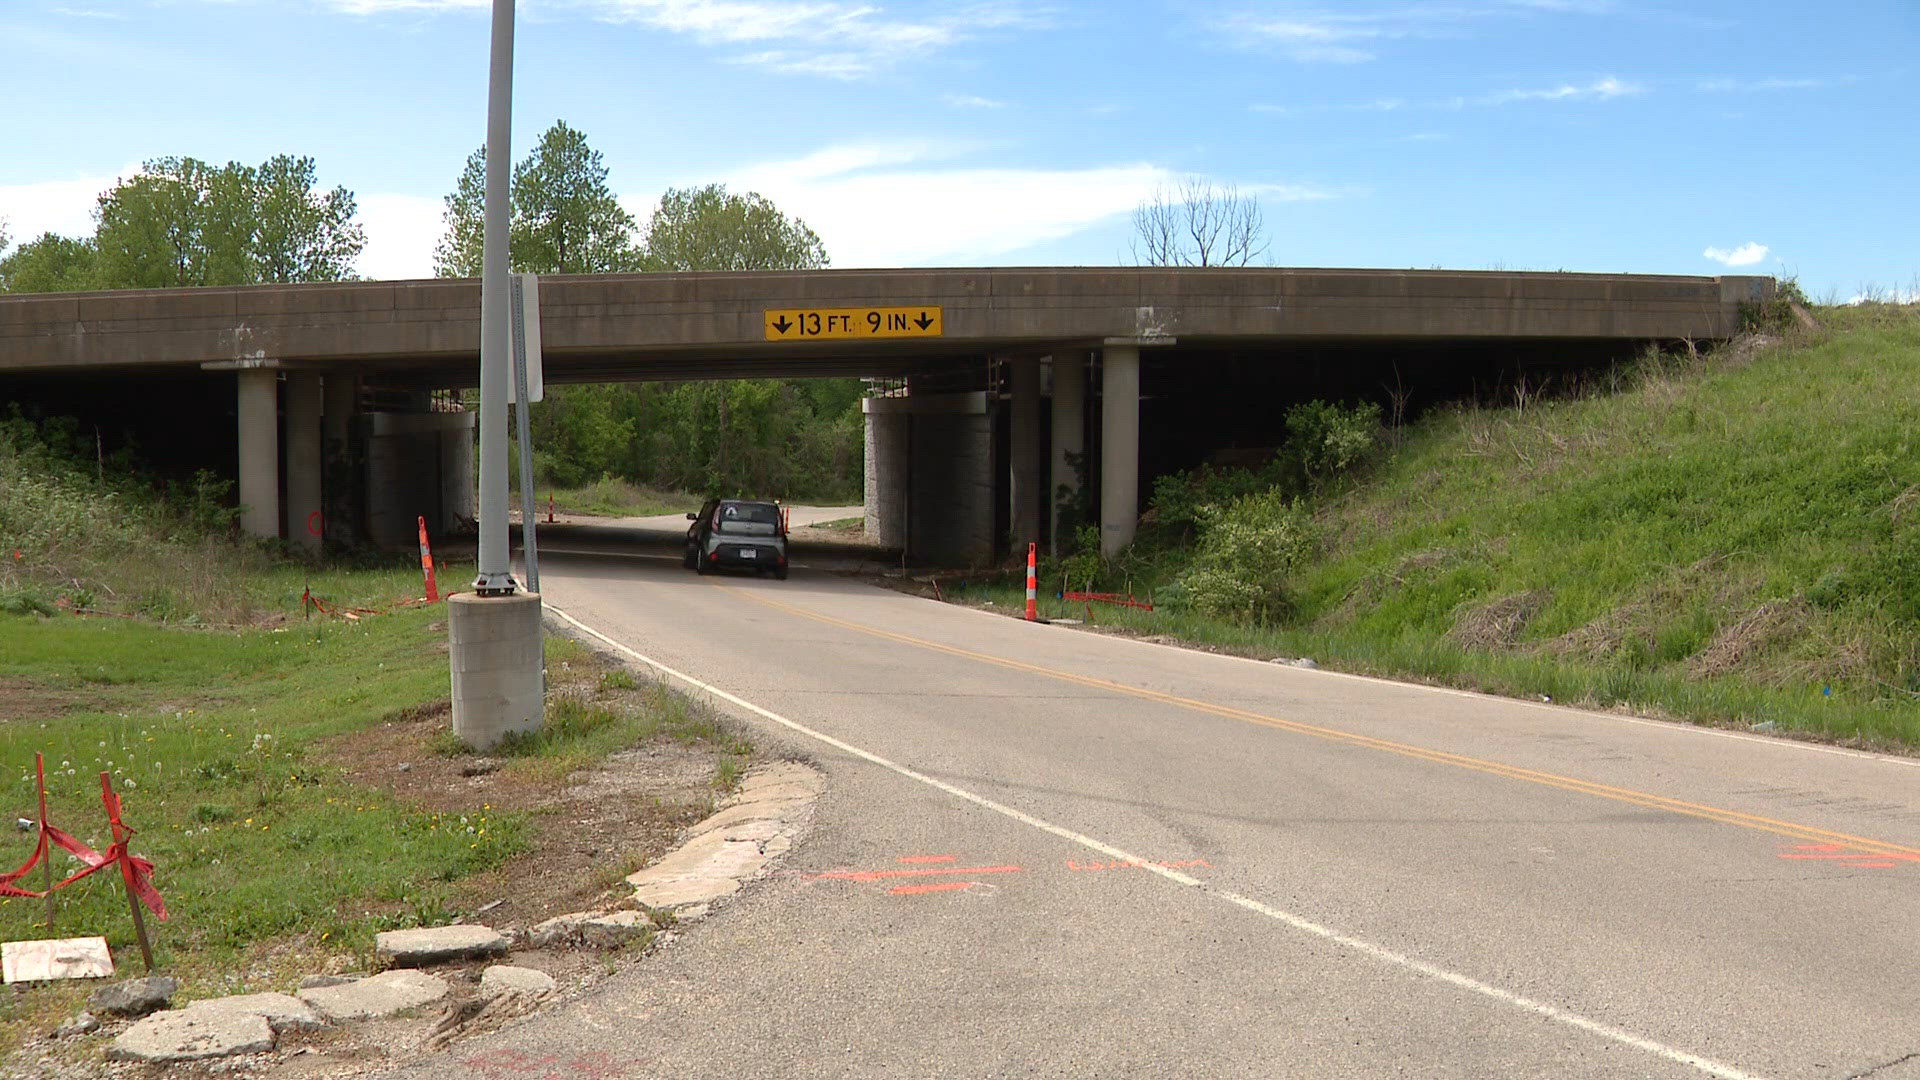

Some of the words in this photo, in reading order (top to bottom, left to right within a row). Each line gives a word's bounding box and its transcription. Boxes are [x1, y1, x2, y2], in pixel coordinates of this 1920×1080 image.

[798, 313, 821, 335] 13
[828, 315, 852, 332] FT.
[867, 312, 881, 333] 9
[888, 314, 911, 331] IN.
